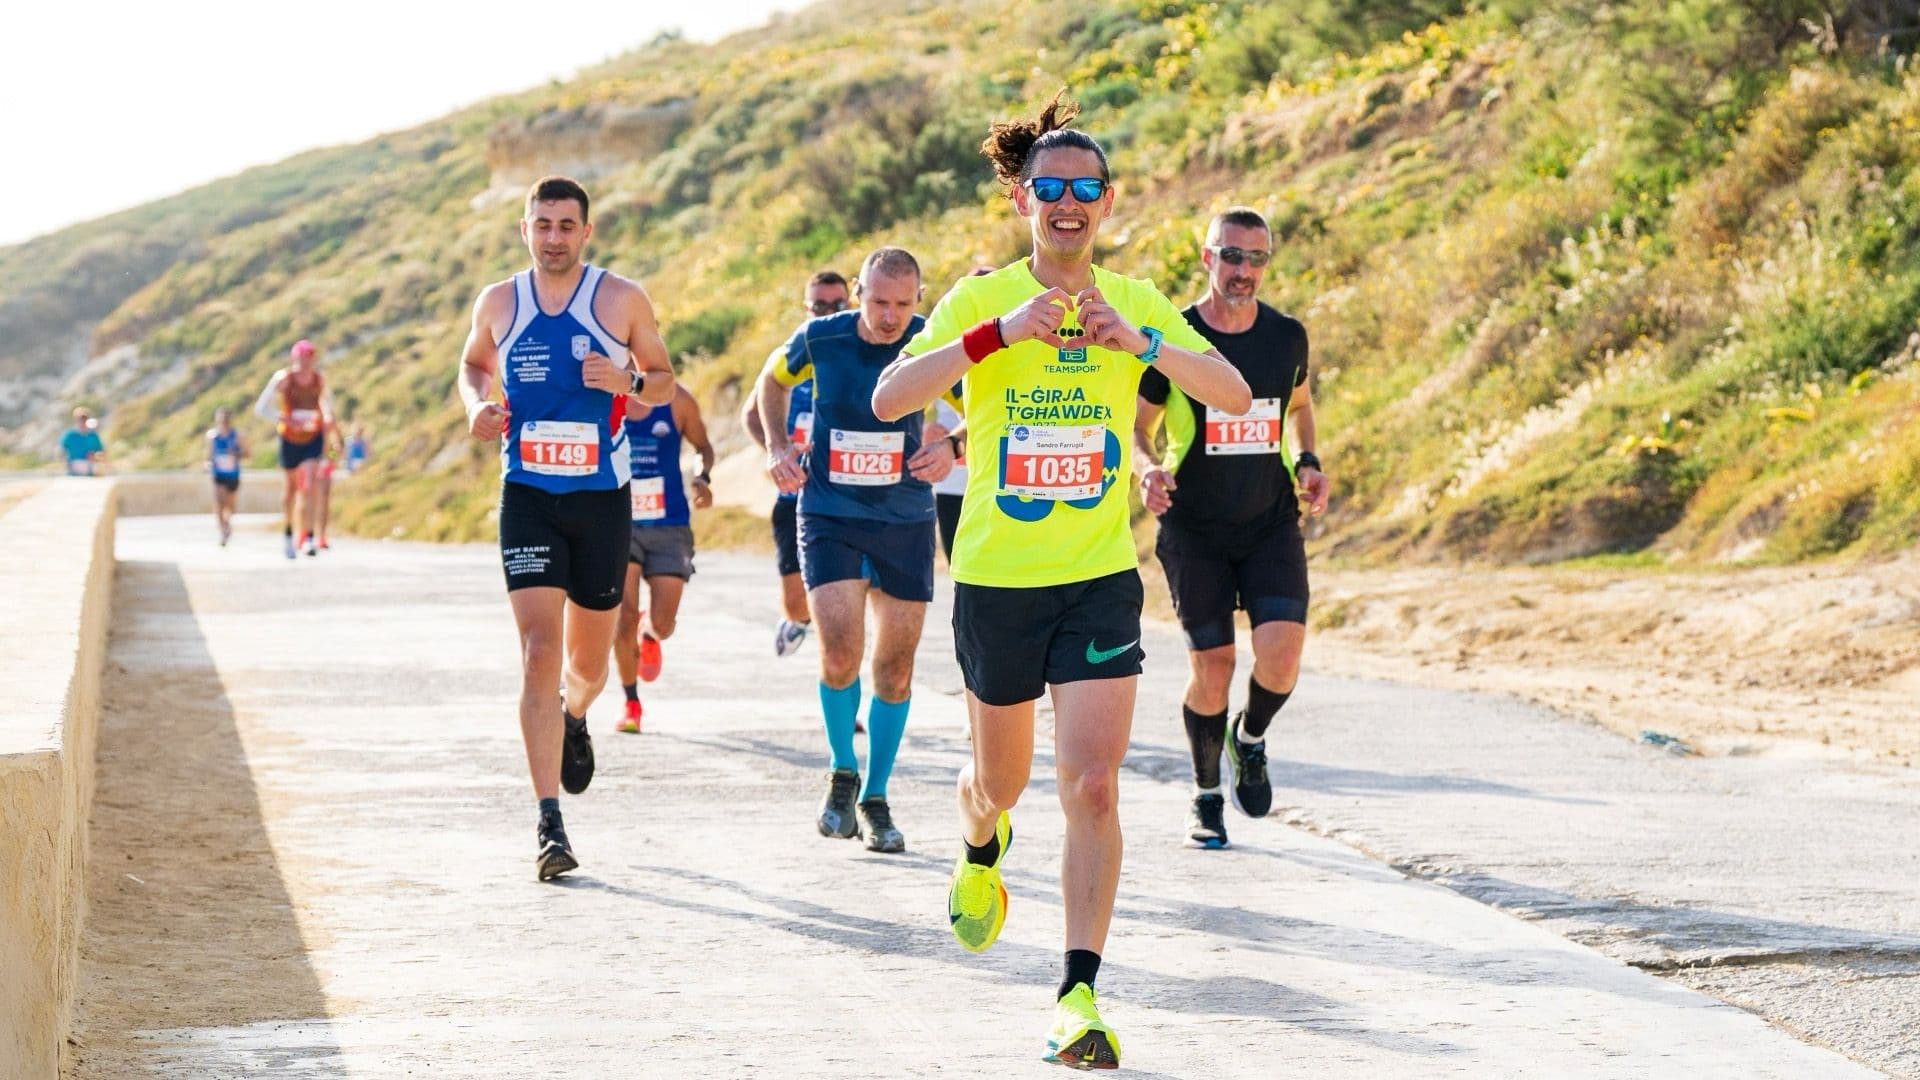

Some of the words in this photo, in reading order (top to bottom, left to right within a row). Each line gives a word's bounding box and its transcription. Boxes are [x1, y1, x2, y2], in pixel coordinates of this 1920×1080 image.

[1044, 365, 1102, 374] TEAMSPORT
[1217, 421, 1270, 443] 1120
[532, 443, 588, 465] 1149
[840, 453, 893, 474] 1026
[1023, 457, 1092, 484] 1035
[503, 547, 521, 555] TEAM
[509, 568, 545, 576] MARATHON
